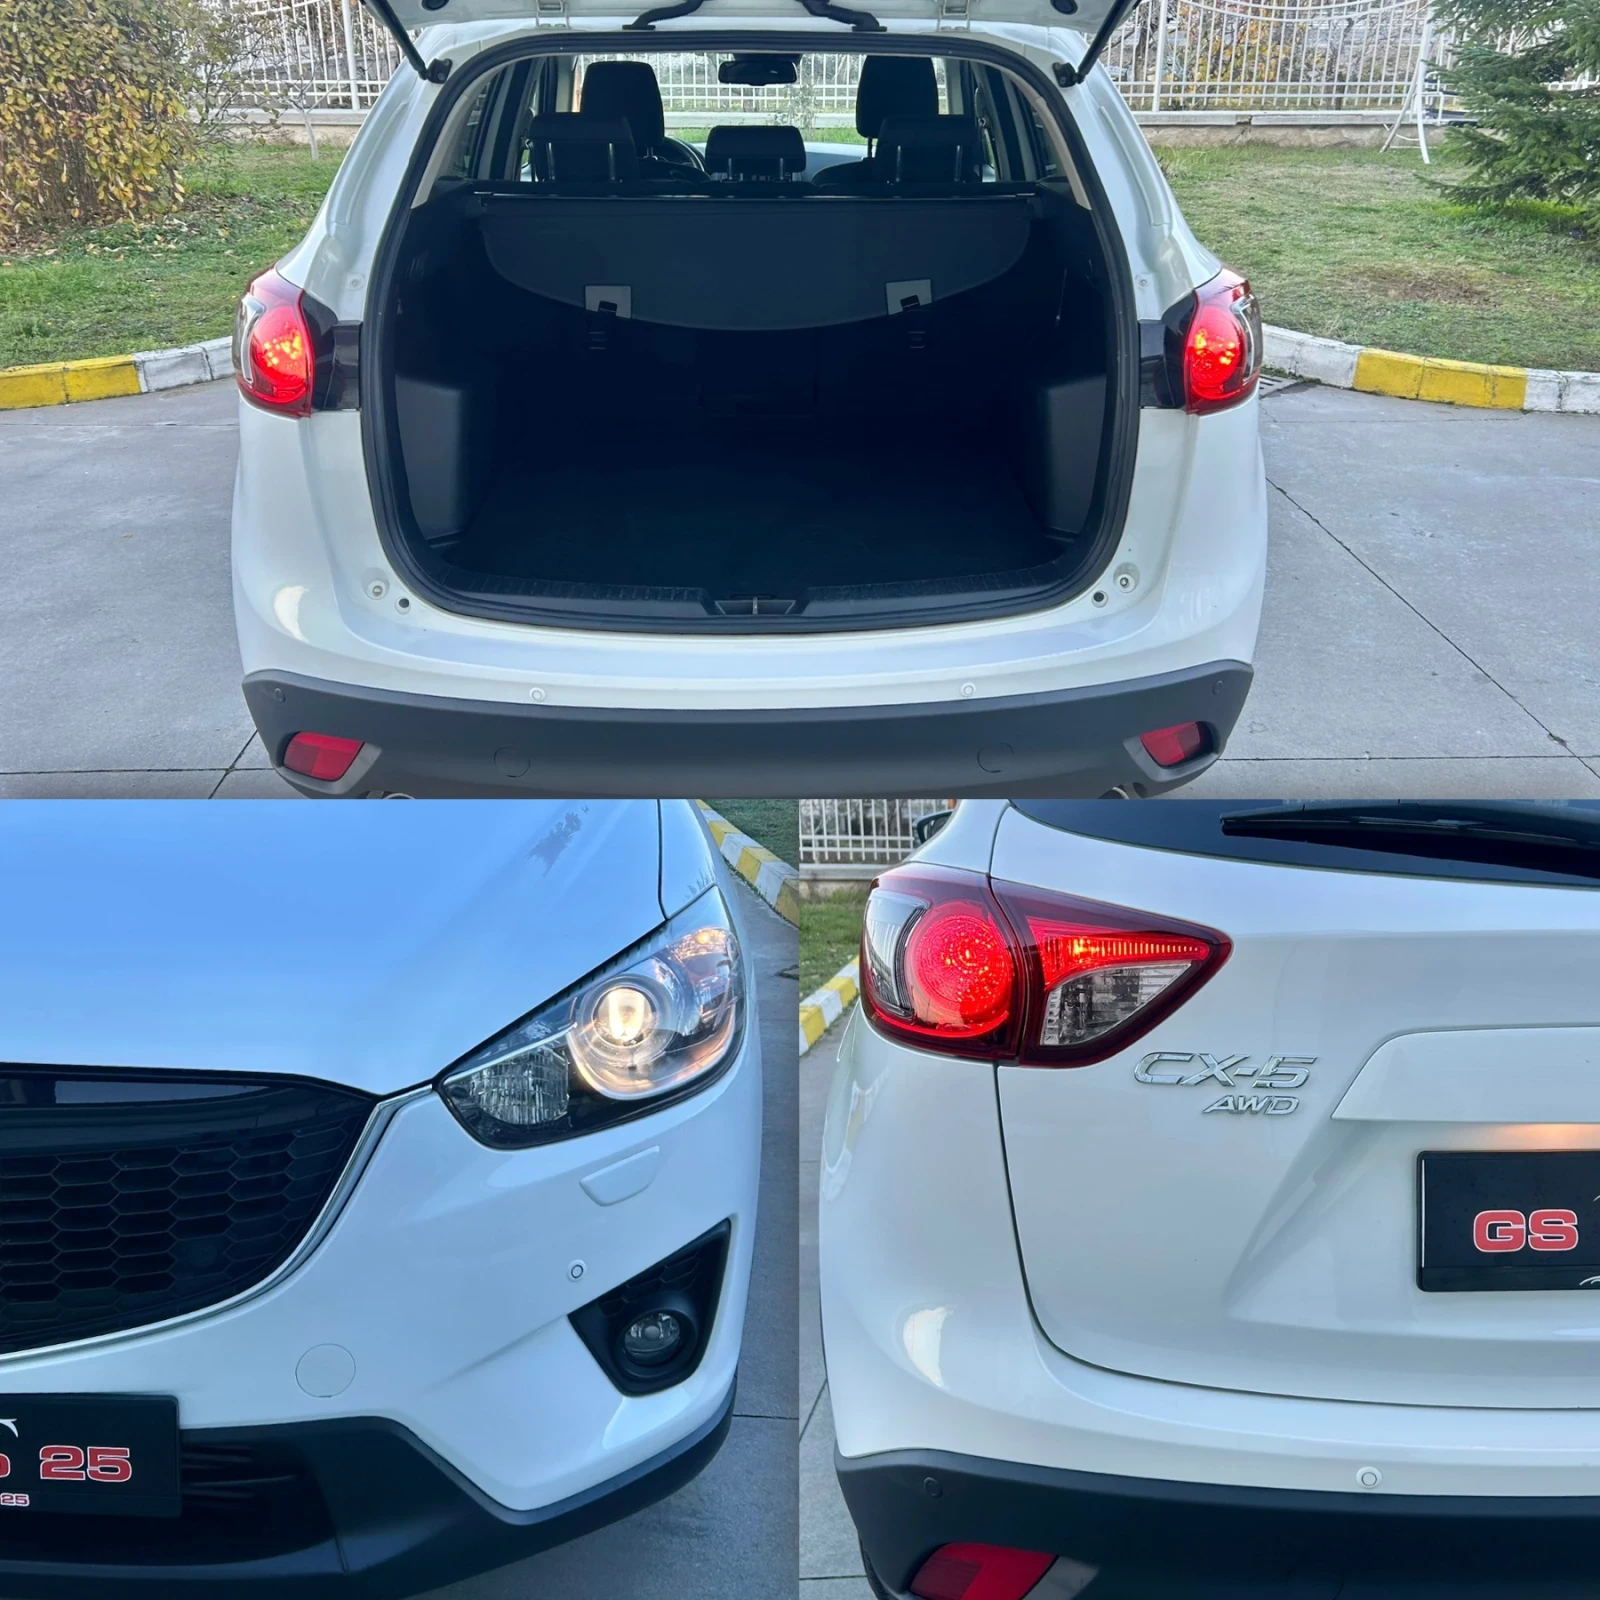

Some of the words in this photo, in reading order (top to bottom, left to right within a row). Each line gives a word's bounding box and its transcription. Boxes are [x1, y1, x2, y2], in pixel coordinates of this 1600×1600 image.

[1134, 1052, 1318, 1088] CX-5
[1202, 1095, 1300, 1115] AWD
[1473, 1209, 1579, 1252] GS
[39, 1445, 132, 1482] 25
[0, 1493, 29, 1507] 25
